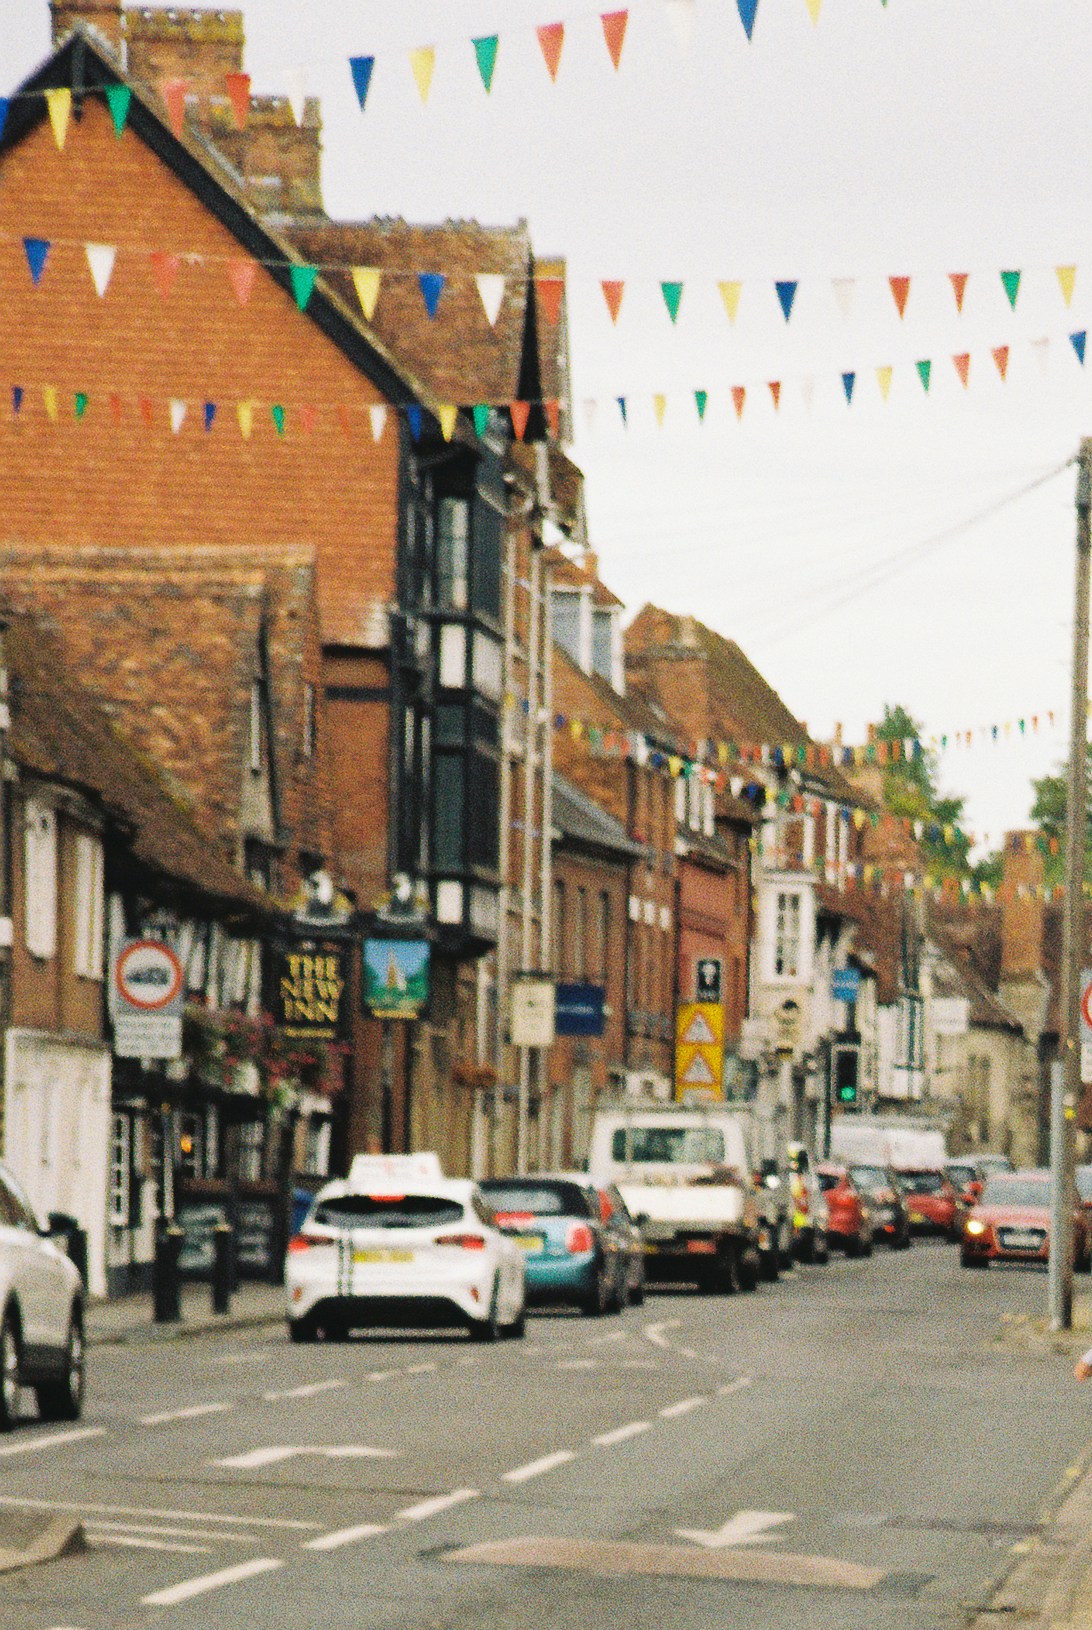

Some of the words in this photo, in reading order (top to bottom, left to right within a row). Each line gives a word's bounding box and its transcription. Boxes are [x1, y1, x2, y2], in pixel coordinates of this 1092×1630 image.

[286, 954, 338, 979] THE
[281, 978, 344, 999] NEW
[284, 999, 338, 1021] INN
